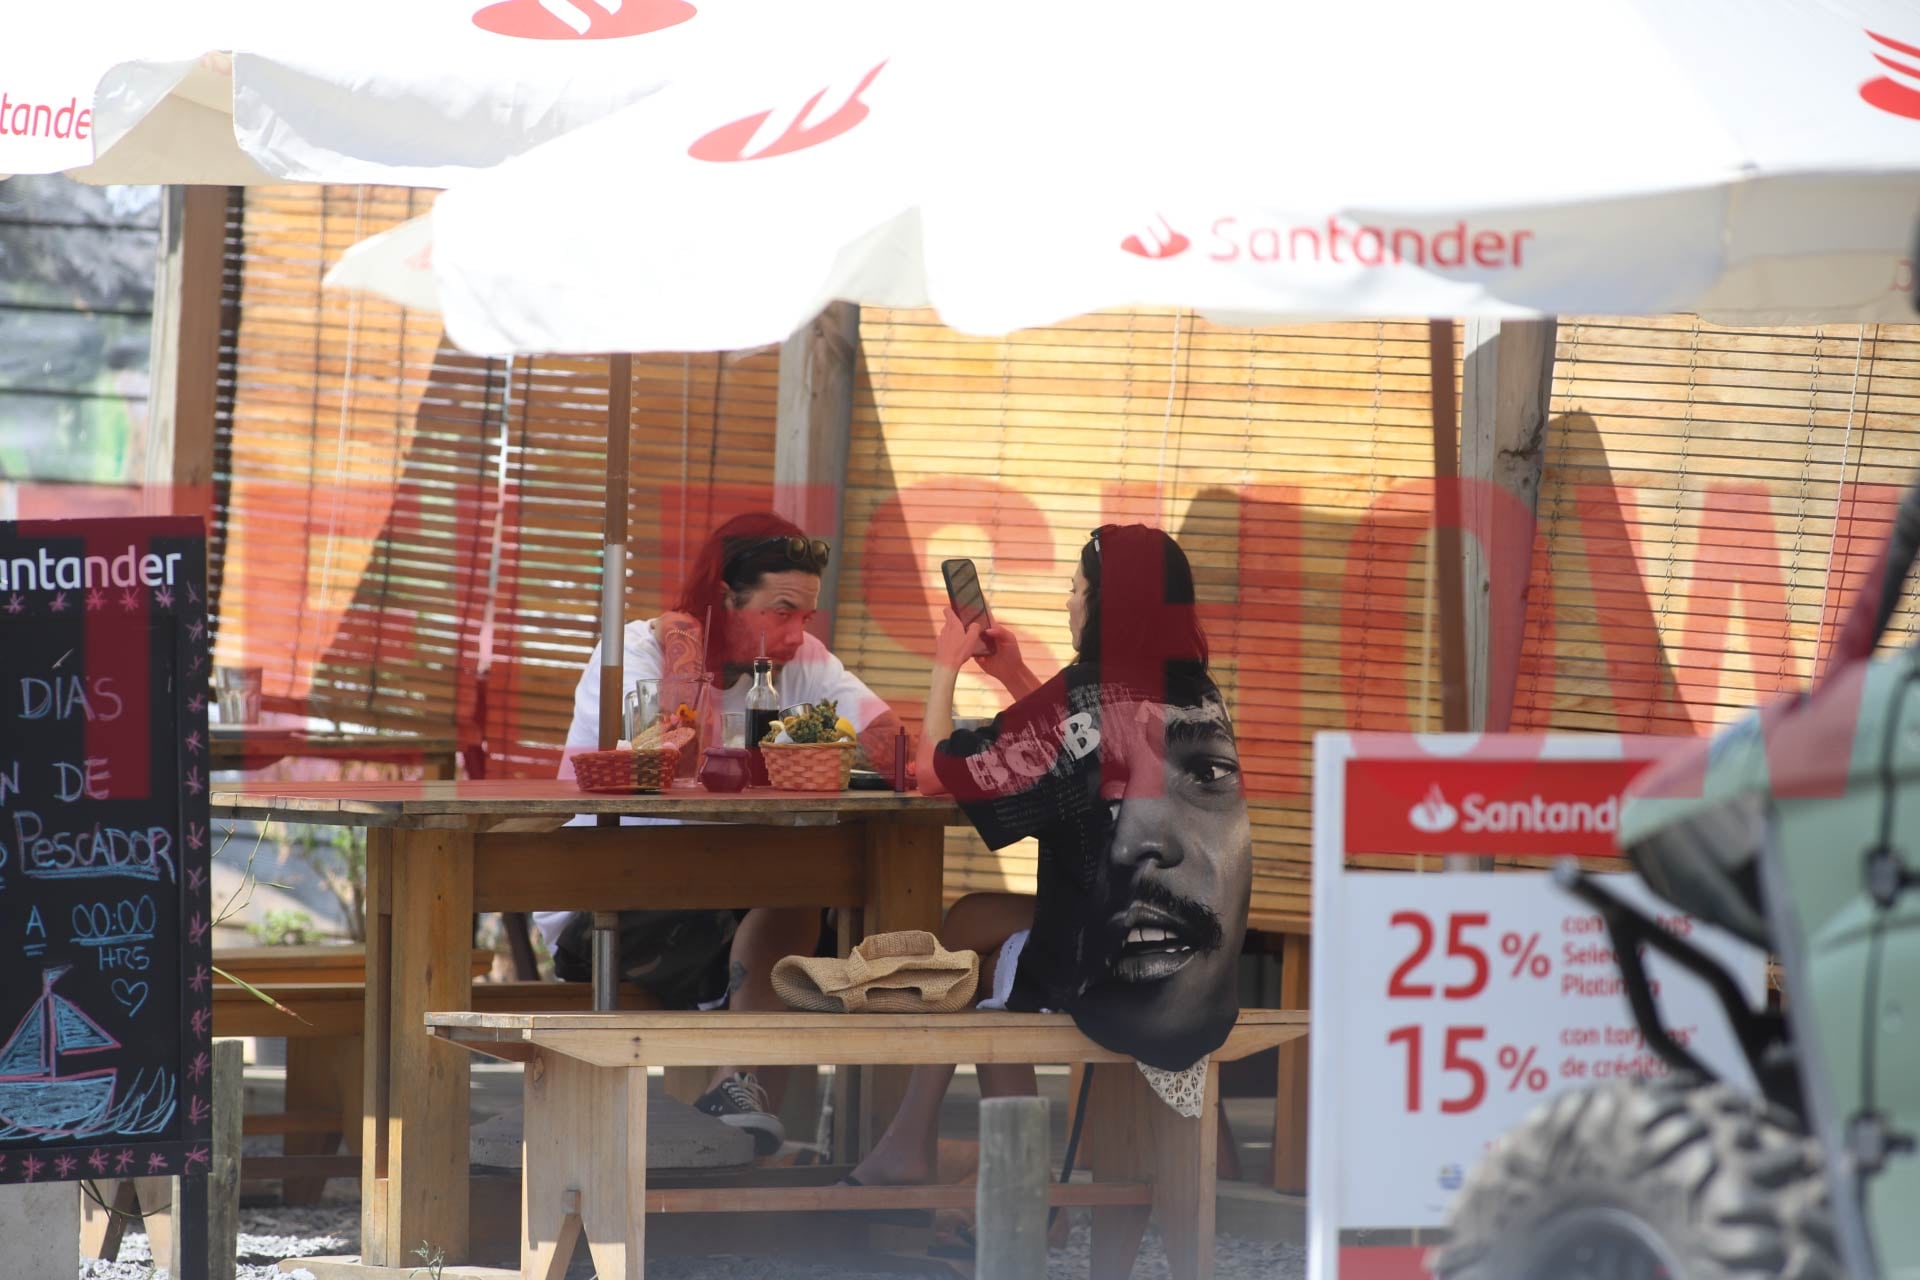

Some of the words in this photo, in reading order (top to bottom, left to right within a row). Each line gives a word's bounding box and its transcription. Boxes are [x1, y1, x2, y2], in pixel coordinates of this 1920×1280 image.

[1208, 215, 1533, 267] Santander
[965, 711, 1101, 792] BOB
[52, 758, 112, 802] DE
[1461, 793, 1618, 833] Santand
[26, 905, 46, 938] A
[71, 895, 156, 938] 00:00
[99, 946, 149, 971] HRS
[1560, 1027, 1601, 1047] con
[1560, 1056, 1588, 1078] de
